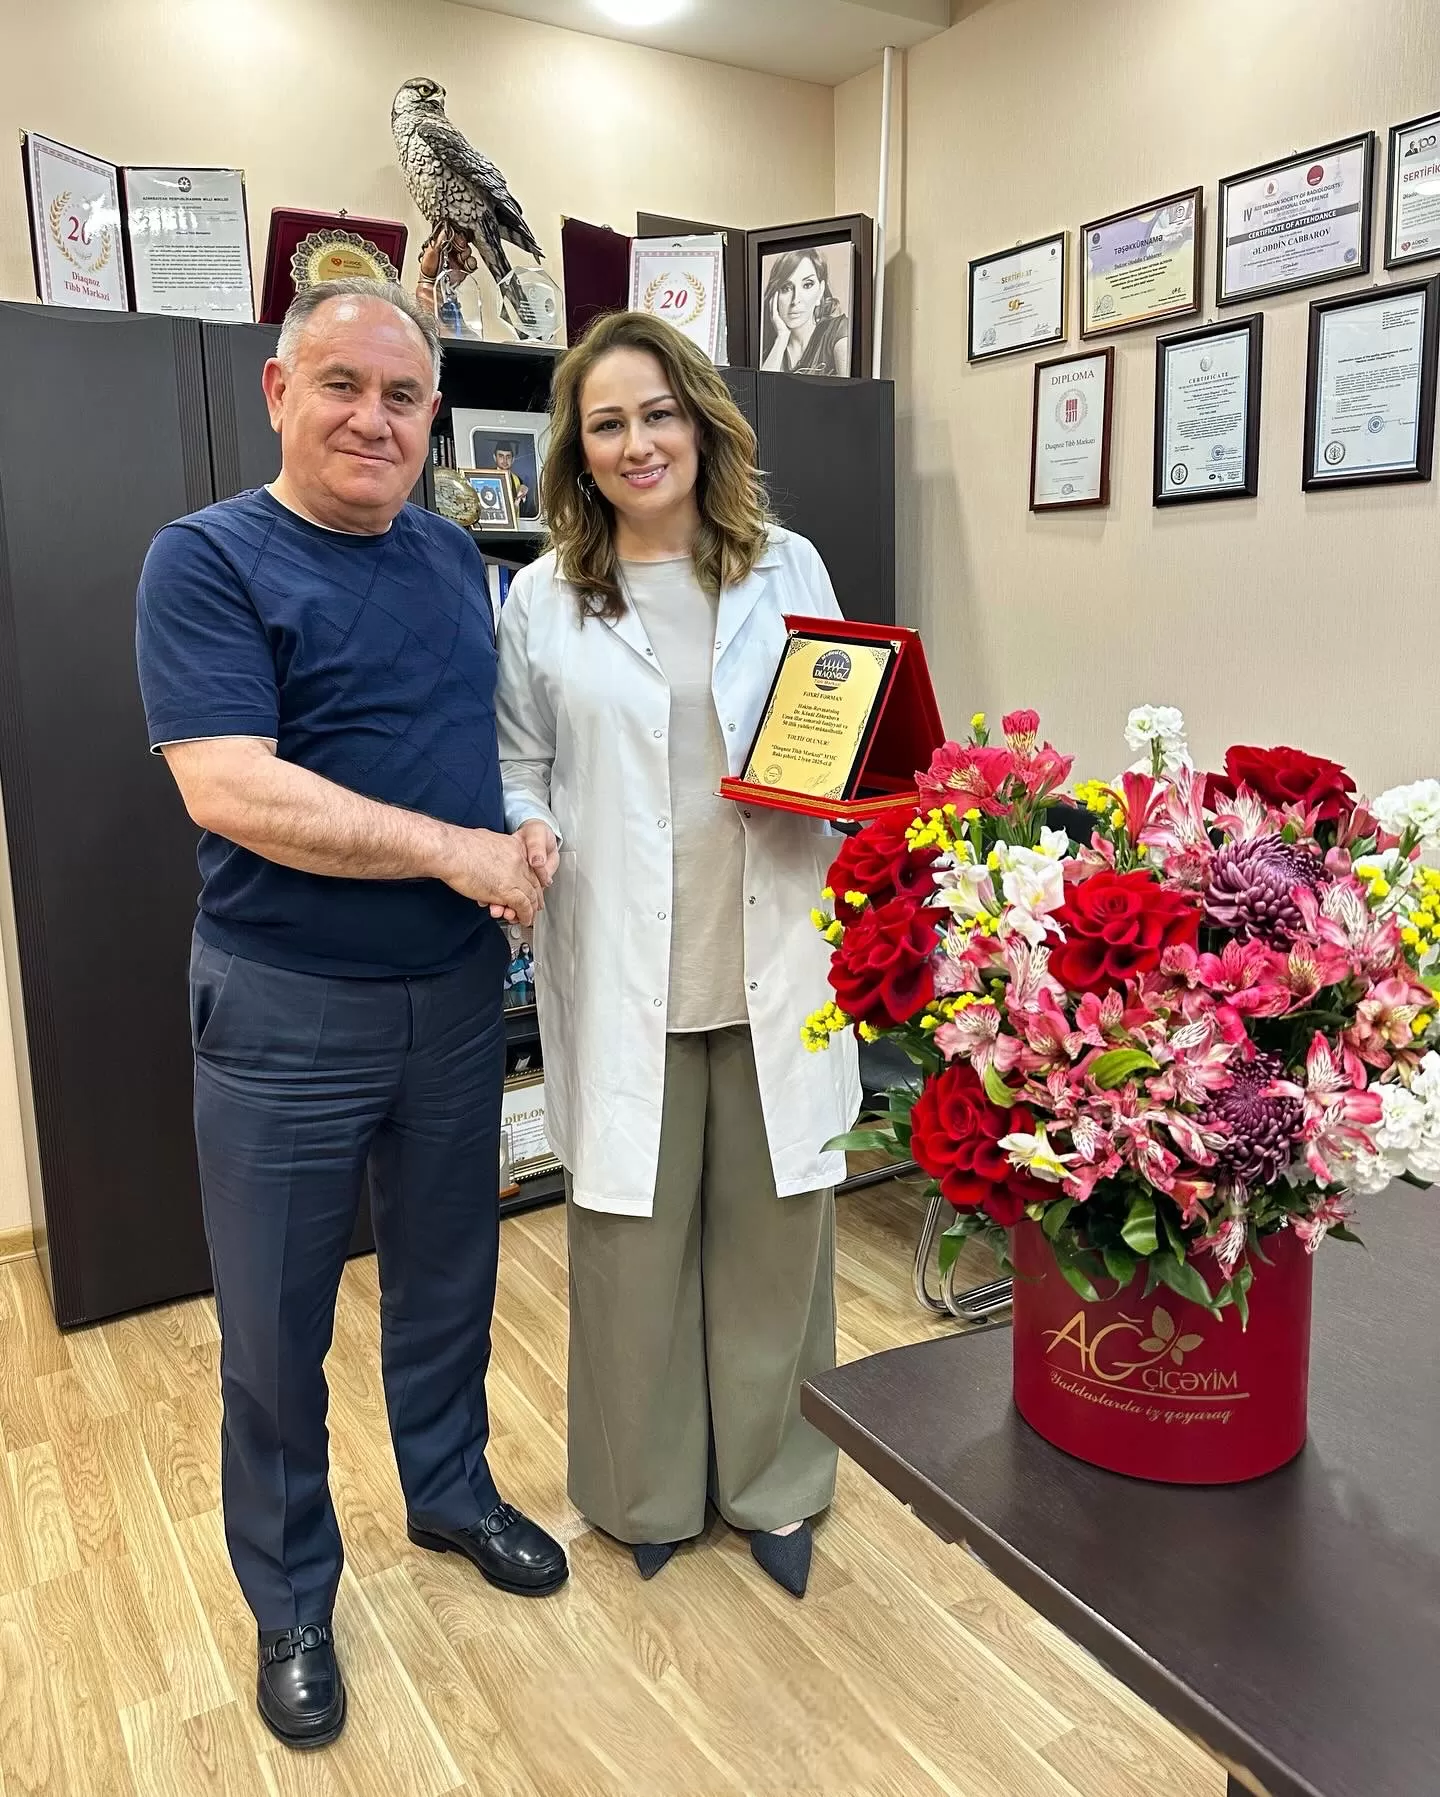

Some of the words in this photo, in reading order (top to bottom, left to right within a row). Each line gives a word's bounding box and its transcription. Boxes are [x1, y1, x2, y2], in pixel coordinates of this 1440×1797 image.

[1263, 202, 1299, 215] INTERNATIONAL
[1299, 194, 1329, 205] CONFERENCE
[1281, 195, 1299, 203] SOCIETY
[1243, 208, 1252, 222] IV
[1248, 224, 1285, 239] CERTIFICATE
[1286, 221, 1294, 229] OF
[1295, 210, 1337, 227] ATTENDANCE
[64, 280, 81, 293] Tibb
[660, 289, 688, 309] 20
[1051, 370, 1095, 386] DIPLOMA
[1188, 372, 1228, 384] CERTIFICATE
[1141, 1366, 1238, 1393] ÇİÇƏYİM
[1145, 1404, 1161, 1421] iz
[1163, 1409, 1232, 1425] qoyaraq
